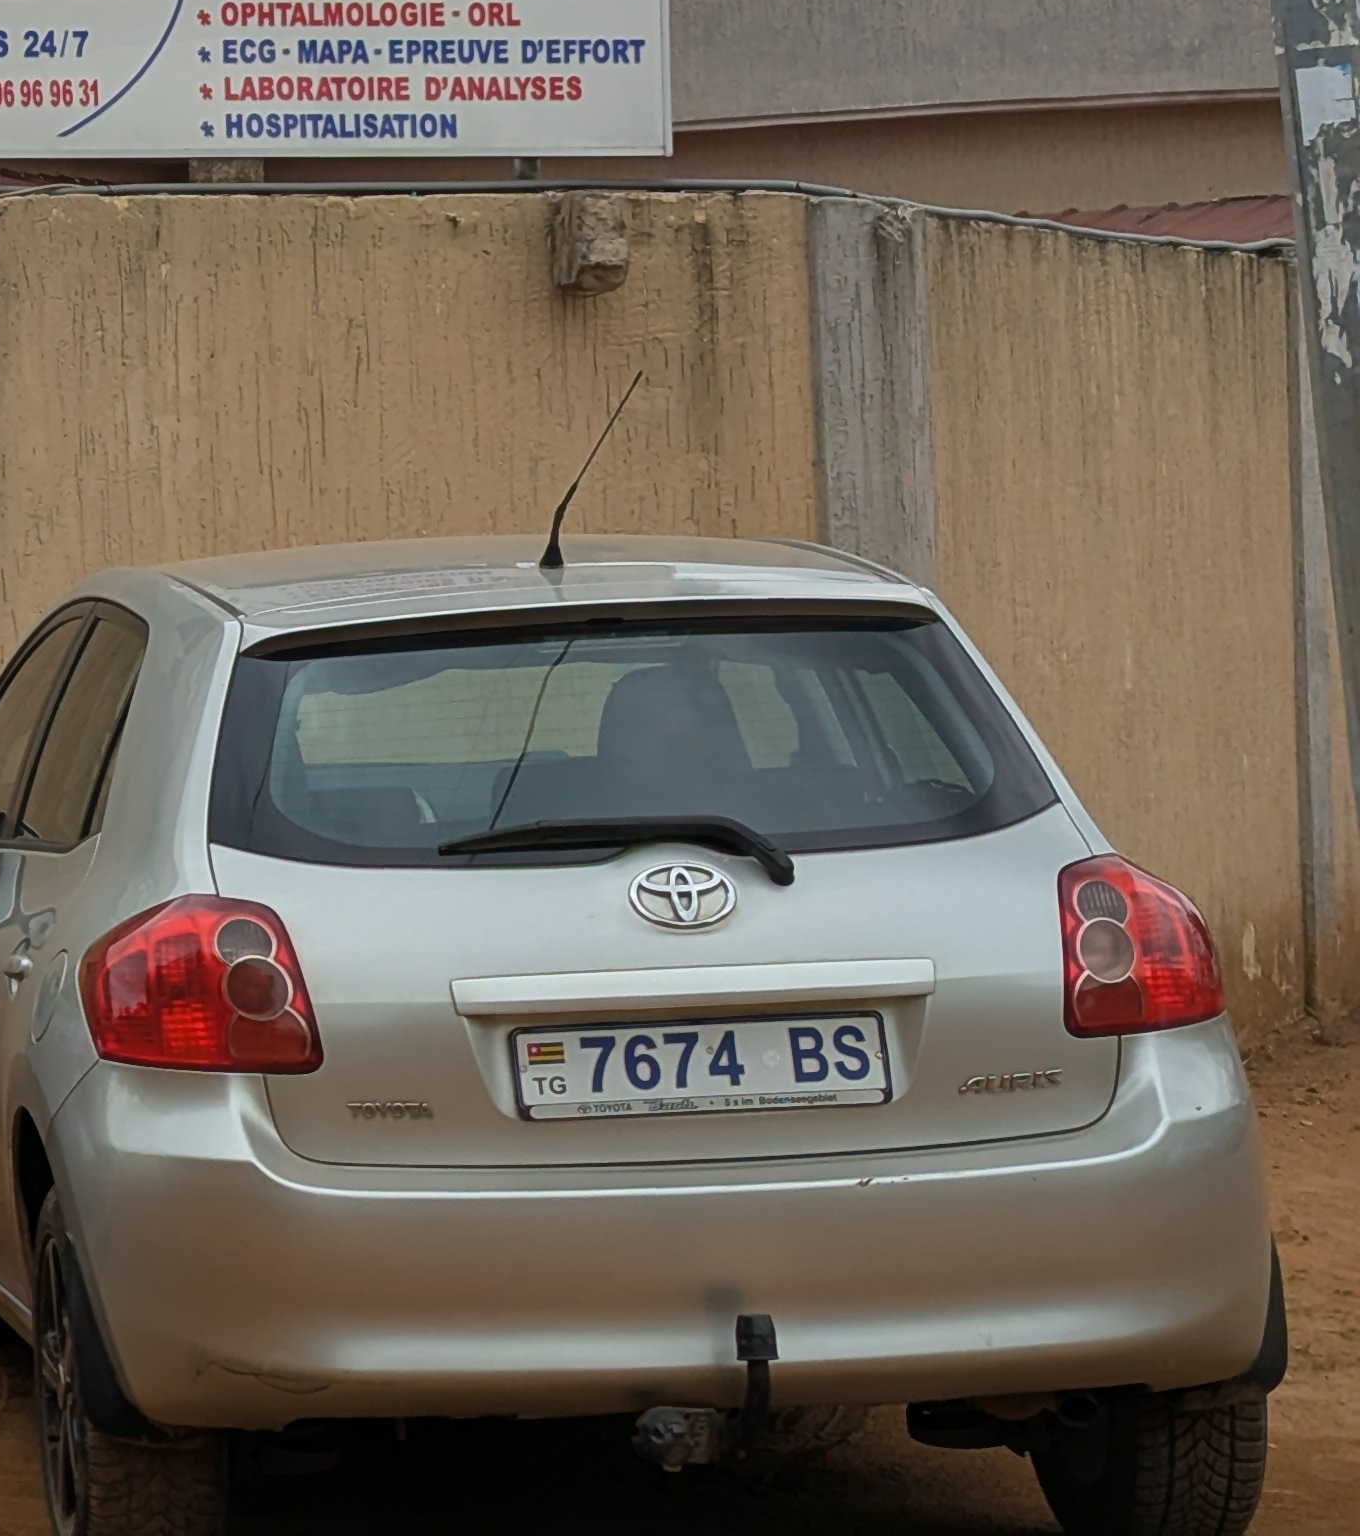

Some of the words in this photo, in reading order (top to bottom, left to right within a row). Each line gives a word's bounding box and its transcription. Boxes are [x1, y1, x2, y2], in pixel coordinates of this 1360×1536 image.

[221, 2, 446, 27] OPHTALMOLOGIE
[467, 2, 522, 27] ORL
[23, 30, 89, 58] 24/7
[222, 39, 276, 64] ECG
[298, 39, 369, 64] MAPA
[388, 39, 508, 64] EPREUVE
[20, 80, 44, 107] 96
[50, 79, 74, 107] 96
[78, 79, 99, 107] 31
[224, 76, 410, 102] LABORATOIRE
[226, 114, 458, 139] HOSPITALISATION
[580, 1030, 746, 1094] 7674
[787, 1025, 872, 1084] BS
[532, 1075, 568, 1097] TG
[958, 1068, 1063, 1095] AURIS
[592, 1103, 633, 1114] TOYOTA
